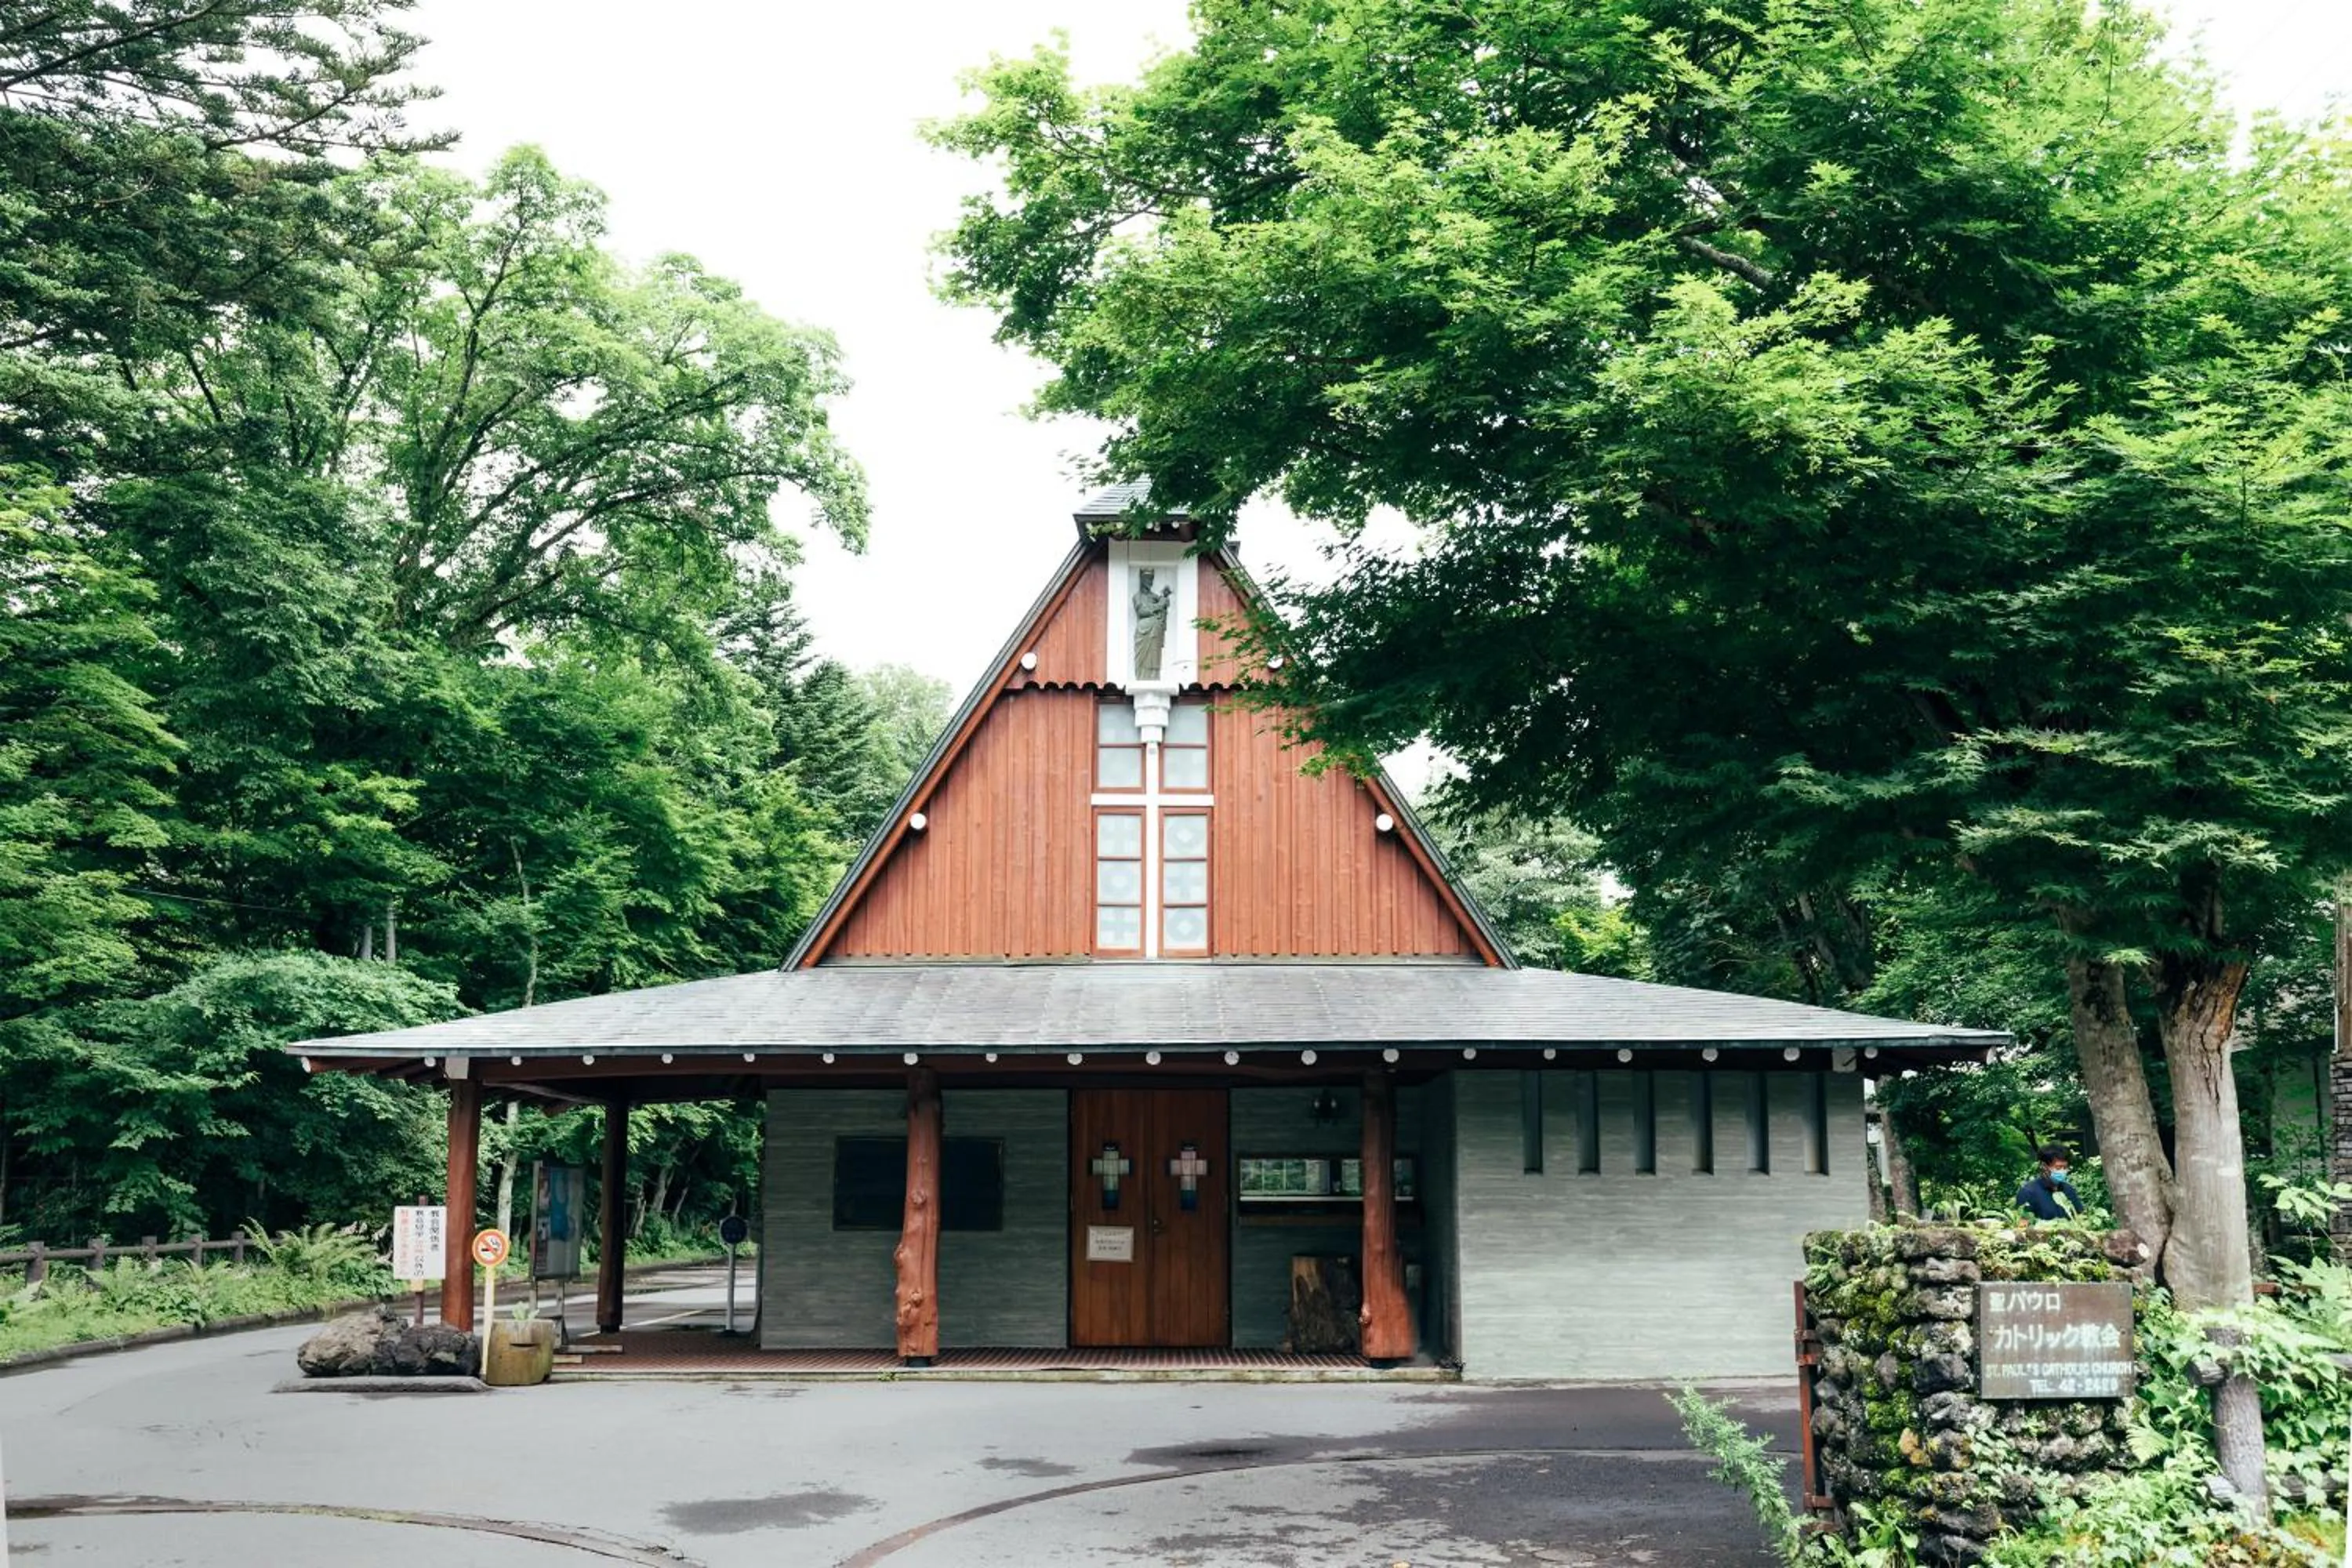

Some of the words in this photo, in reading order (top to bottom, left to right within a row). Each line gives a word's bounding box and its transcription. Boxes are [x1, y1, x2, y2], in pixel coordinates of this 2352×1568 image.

[1989, 1290, 2061, 1312] 聖パウロ
[1994, 1323, 2121, 1350] カトリック教会
[2042, 1362, 2089, 1377] CATHOLIC
[2091, 1361, 2132, 1374] CHURCH
